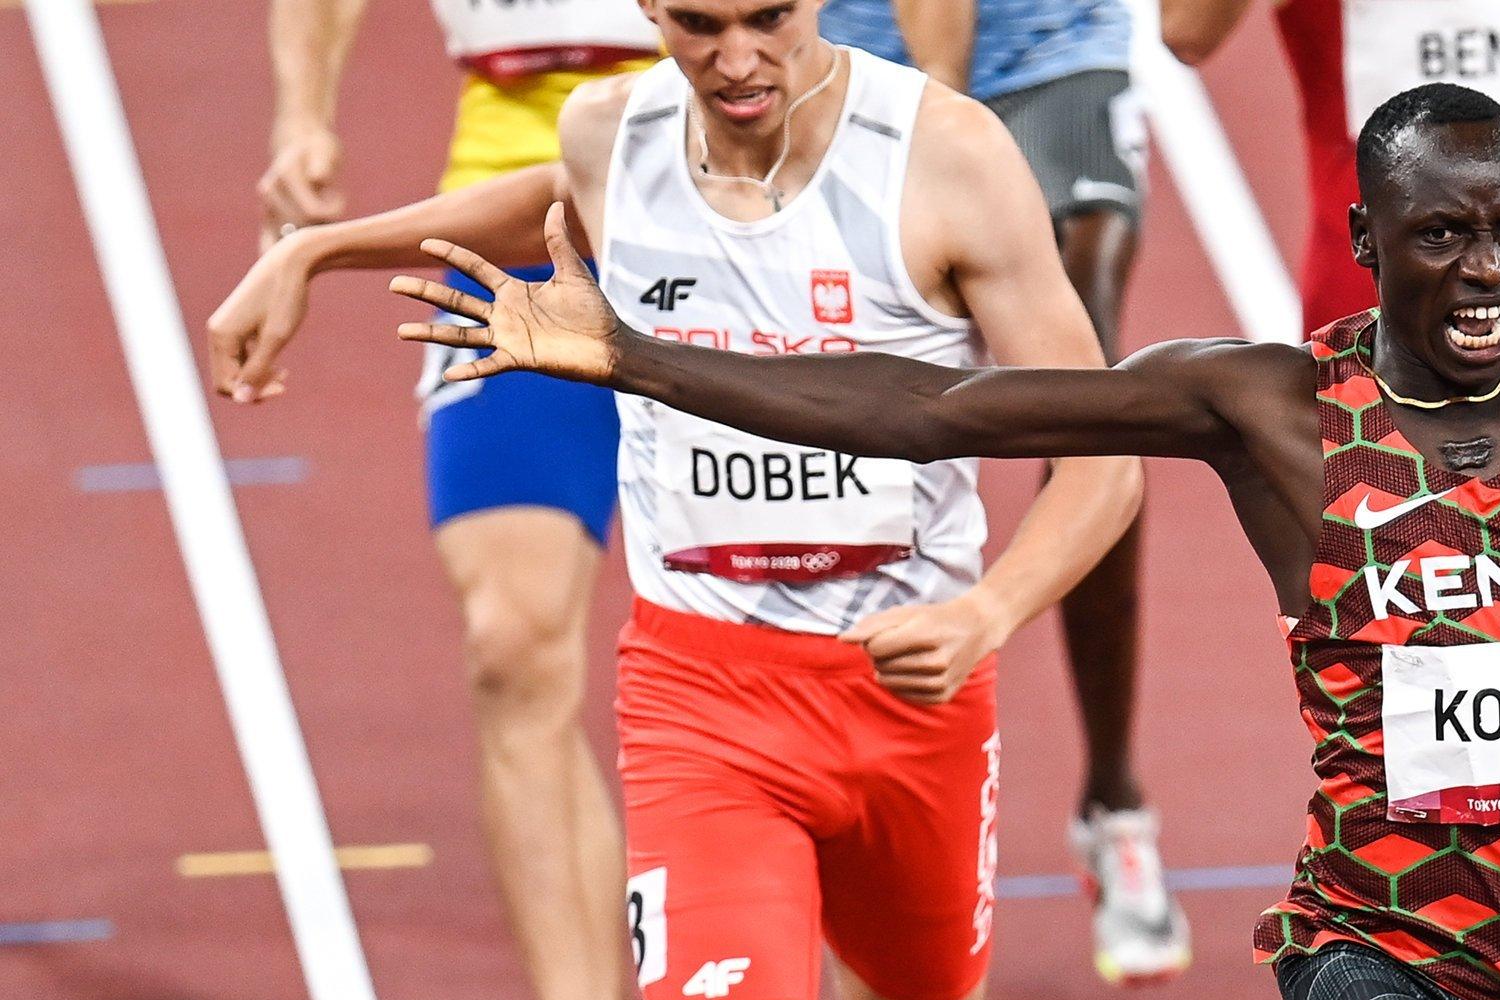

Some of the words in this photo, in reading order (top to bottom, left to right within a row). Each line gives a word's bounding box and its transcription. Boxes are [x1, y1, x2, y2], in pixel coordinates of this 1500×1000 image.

[640, 278, 697, 311] 4F
[691, 448, 869, 501] DOBEK
[682, 957, 751, 999] 4F
